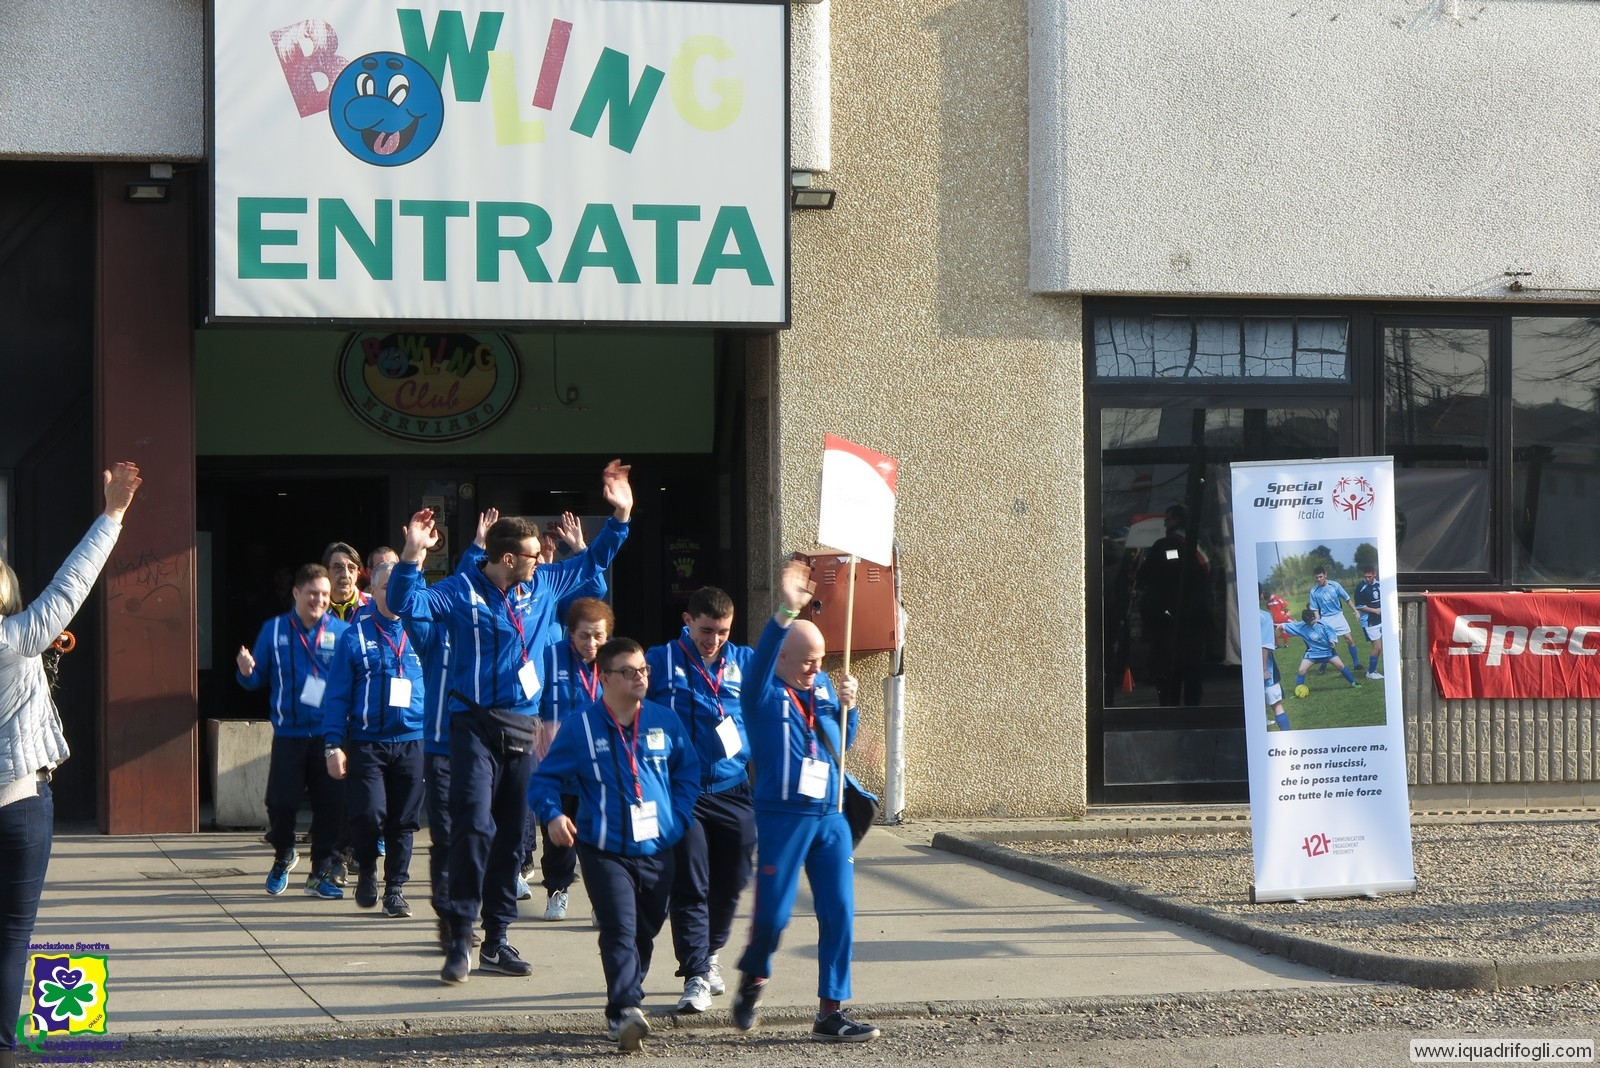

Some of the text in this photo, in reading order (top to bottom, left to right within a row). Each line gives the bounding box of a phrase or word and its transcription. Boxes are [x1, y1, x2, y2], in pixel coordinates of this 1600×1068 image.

[269, 8, 744, 167] BOWLING
[238, 197, 774, 287] ENTRATA
[361, 335, 496, 379] BOWLING
[395, 380, 460, 410] Club
[362, 396, 495, 434] NERVIANO
[1267, 481, 1323, 494] Special
[1253, 496, 1324, 509] Olympics
[1298, 509, 1325, 520] Italia
[1268, 744, 1388, 757] Che io possa vincere ma,
[1290, 758, 1367, 771] se non riuscissi,
[1281, 773, 1378, 787] che io possa tentare
[1298, 791, 1322, 800] tutte
[1323, 790, 1333, 799] le
[1335, 788, 1354, 798] mie
[1356, 787, 1382, 797] forze
